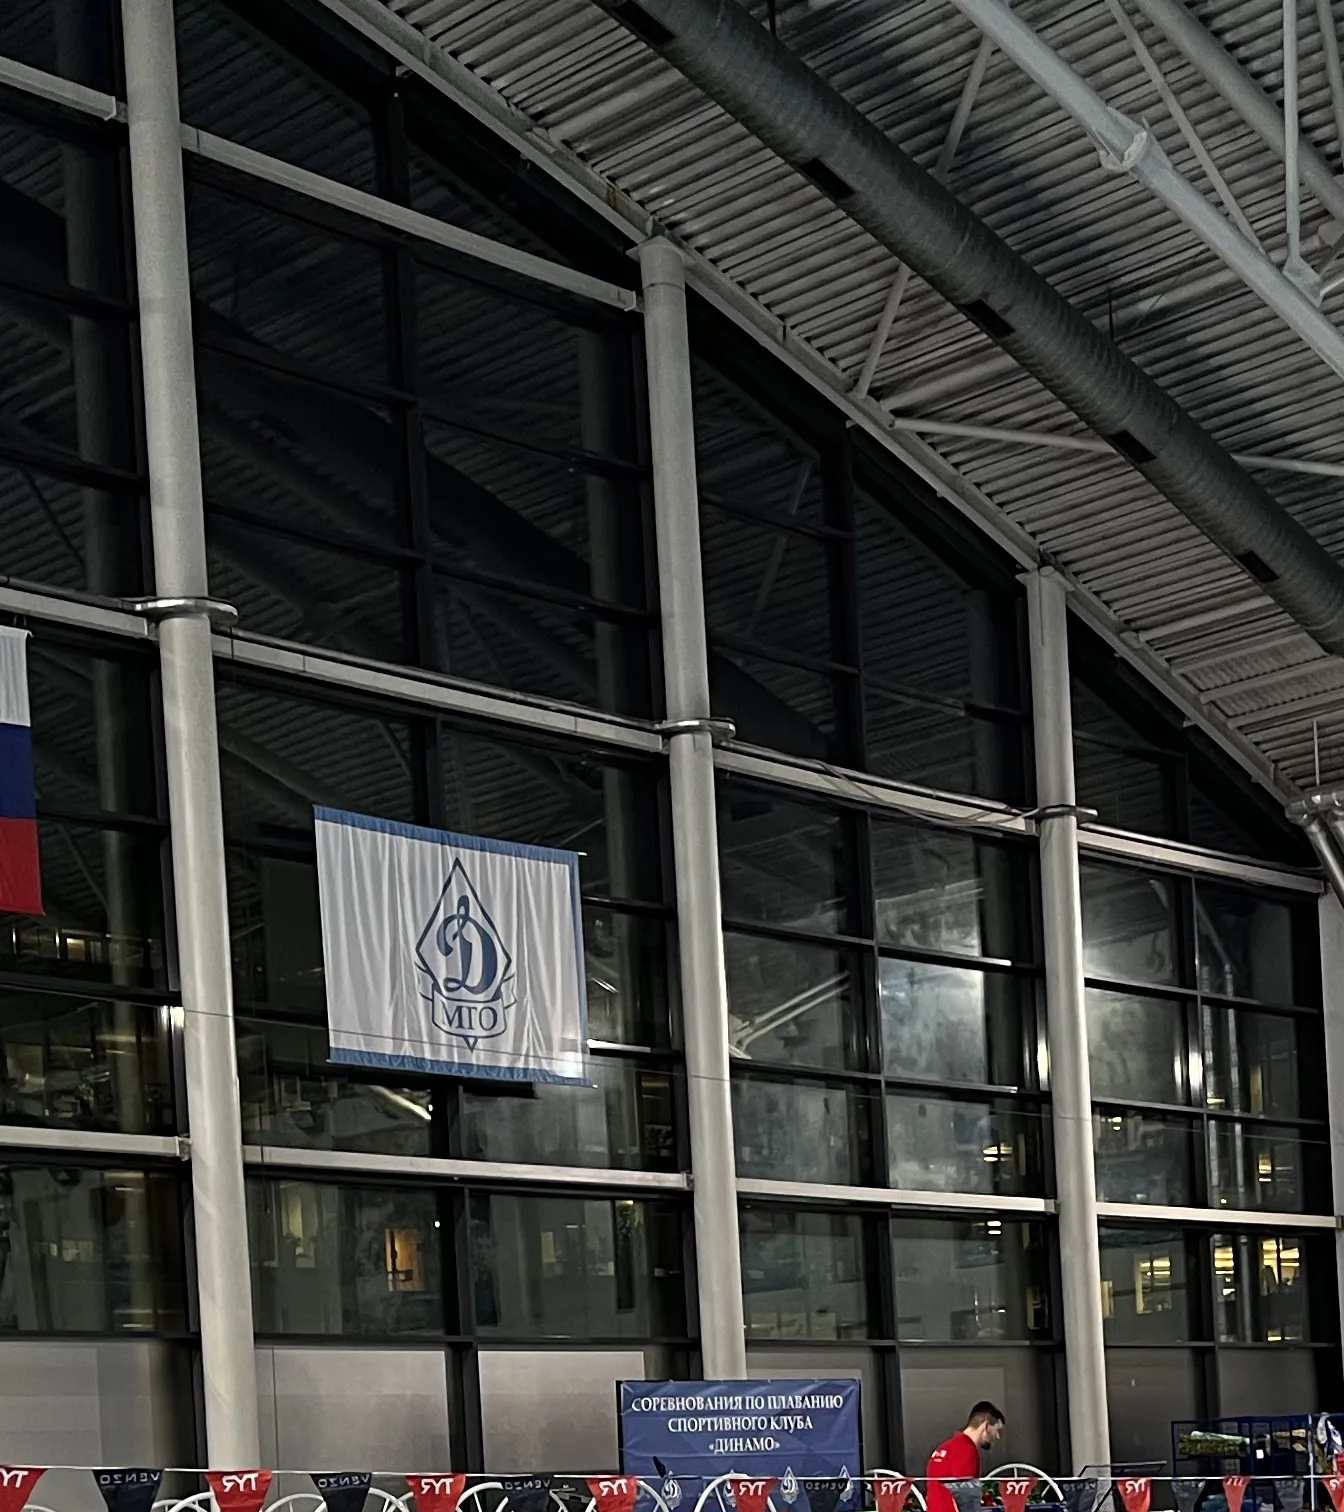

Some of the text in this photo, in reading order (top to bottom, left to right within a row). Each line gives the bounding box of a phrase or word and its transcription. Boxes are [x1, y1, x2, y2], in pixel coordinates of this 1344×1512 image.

[631, 1395, 844, 1412] СОРЕВНОВАНИЯ ПО ПЛАВАНИЮ
[667, 1416, 813, 1433] СПОРТИВНОГО КЛУБА
[708, 1437, 780, 1455] «ДИНАМО»
